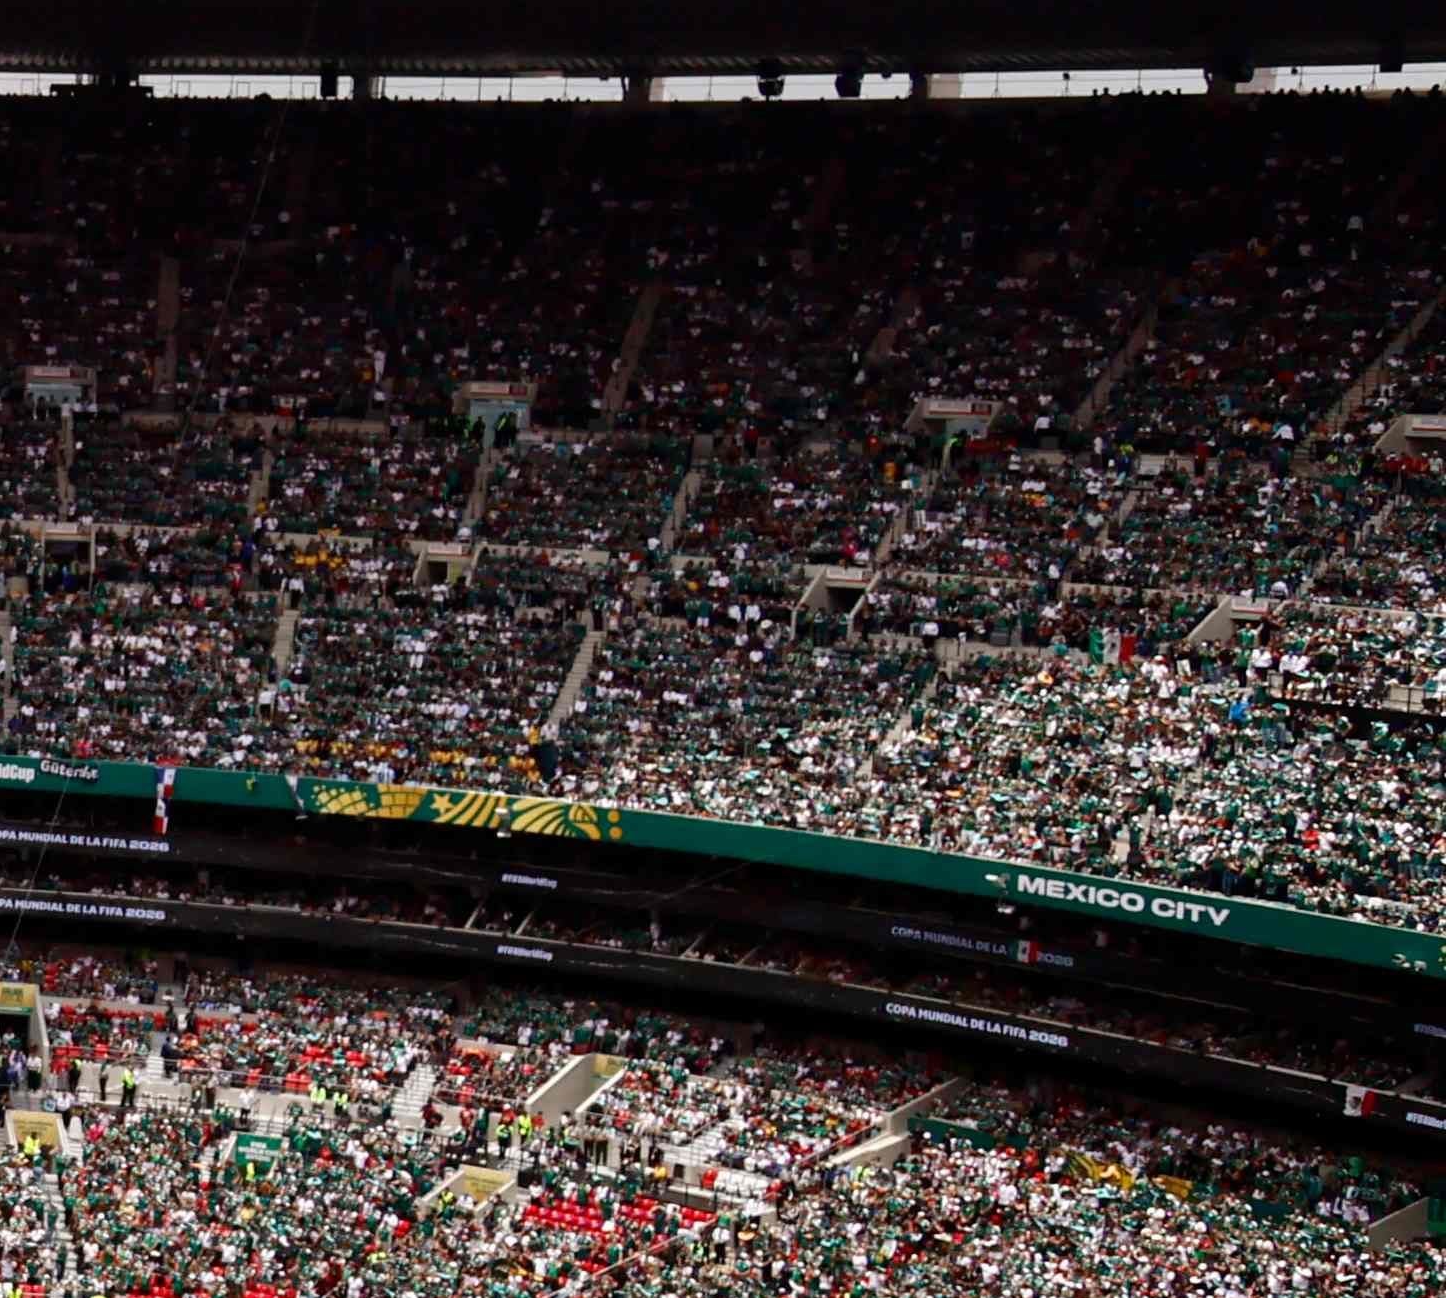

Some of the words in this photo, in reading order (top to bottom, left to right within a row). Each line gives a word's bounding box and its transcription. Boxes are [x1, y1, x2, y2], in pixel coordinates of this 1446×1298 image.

[20, 832, 68, 844] MUNDIAL
[70, 835, 85, 845] DE
[87, 837, 101, 846] LA
[103, 837, 127, 849] FIFA
[16, 900, 65, 912] MUNDIAL
[67, 904, 82, 913] DE
[83, 905, 98, 914] LA
[100, 906, 123, 917] FIFA
[1017, 875, 1145, 913] MEXICO
[1151, 898, 1231, 926] CITY
[886, 1002, 916, 1018] COPA
[918, 1008, 968, 1028] MUNDIAL
[970, 1018, 985, 1031] DE
[986, 1020, 1001, 1034] LA
[1003, 1024, 1027, 1040] FIFA
